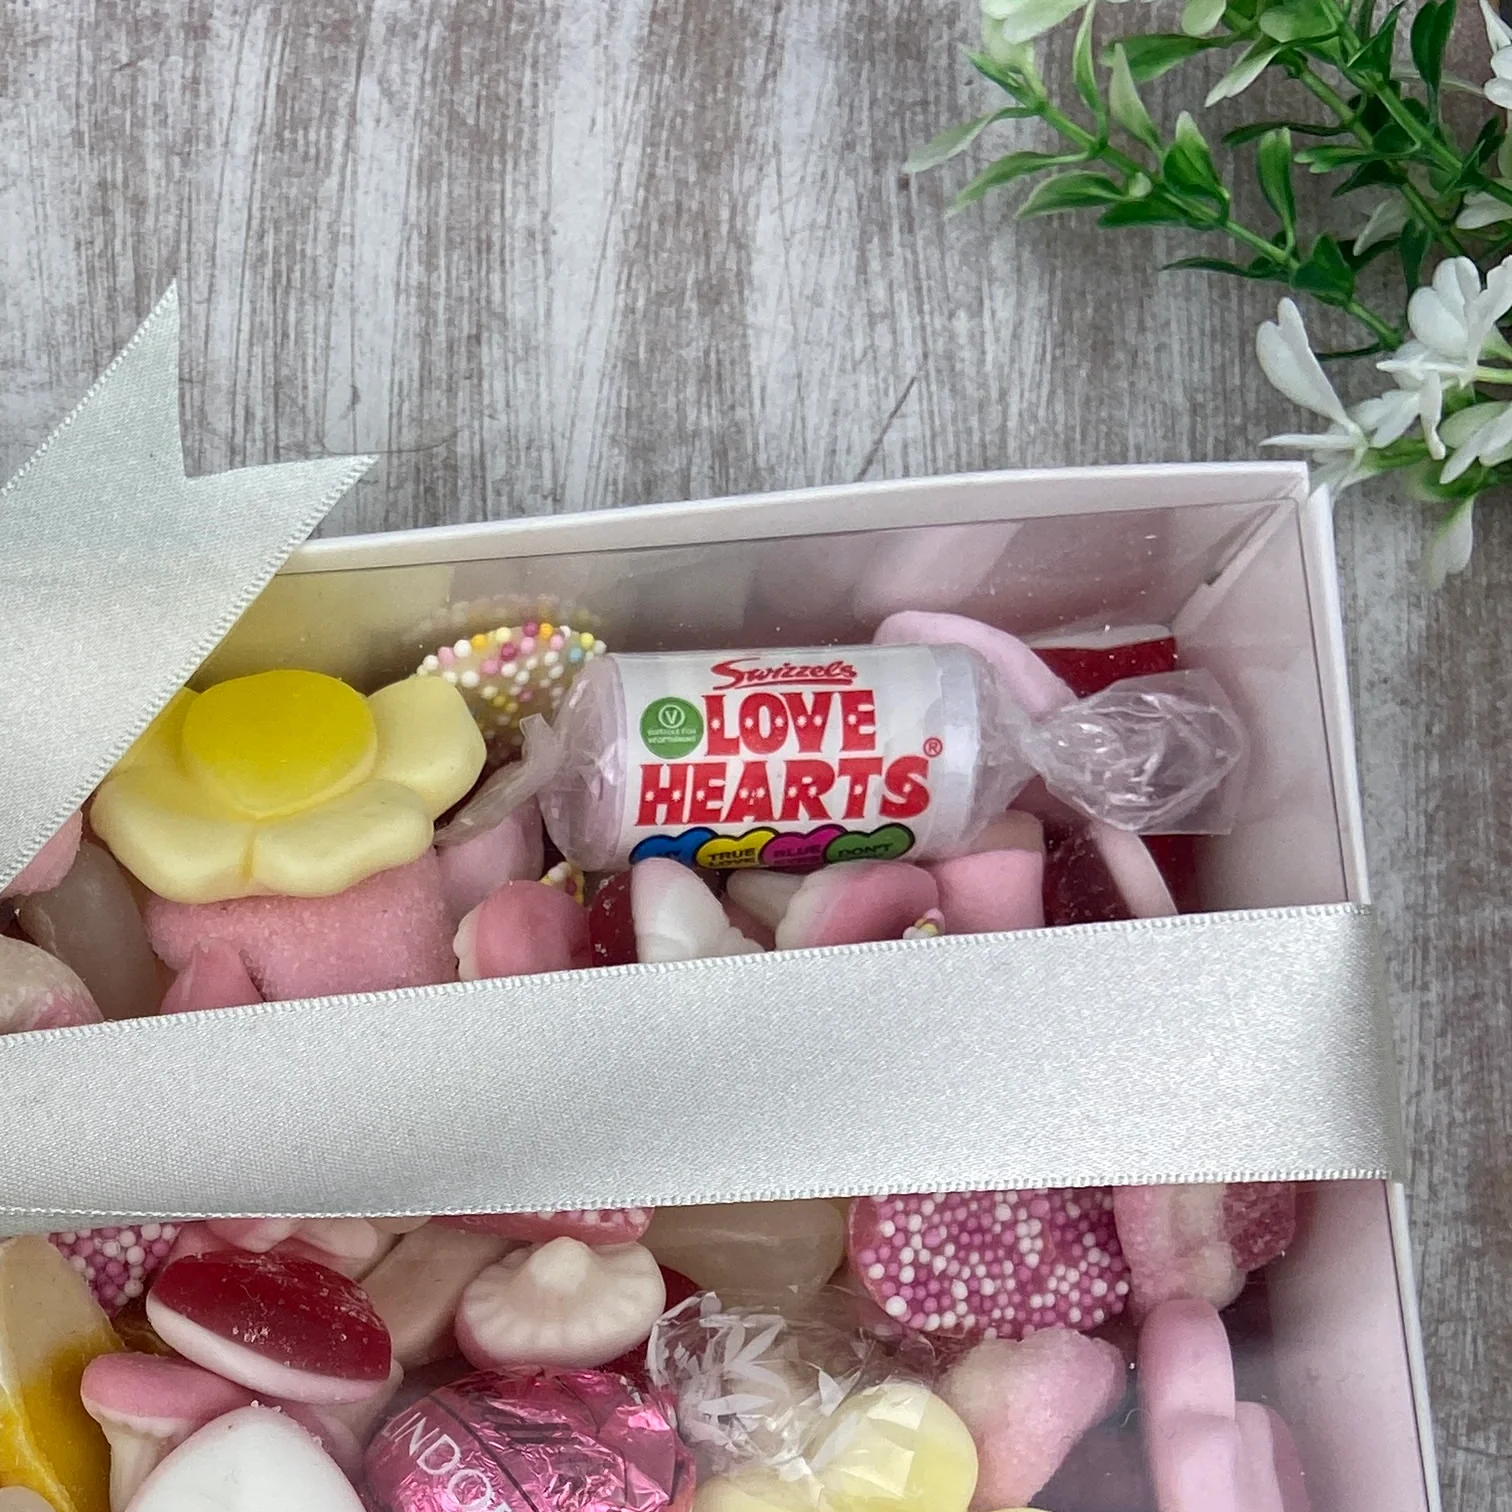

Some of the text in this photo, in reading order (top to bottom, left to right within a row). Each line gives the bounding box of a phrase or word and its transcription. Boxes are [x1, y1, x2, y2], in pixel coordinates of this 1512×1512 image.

[710, 656, 858, 690] Swizzels
[701, 689, 876, 756] LOVE
[635, 756, 931, 828] HEARTS
[707, 848, 755, 861] TRUE
